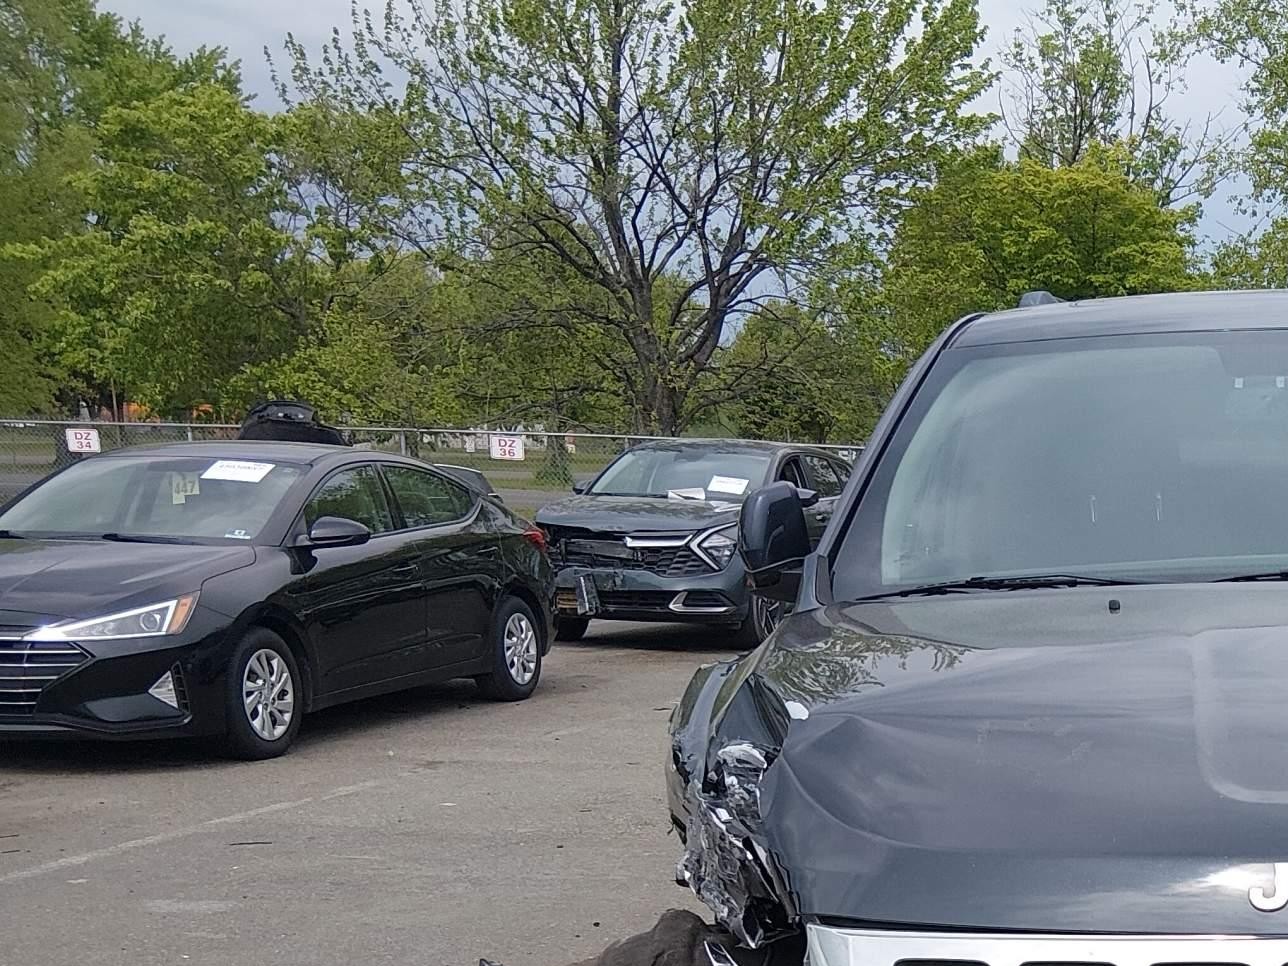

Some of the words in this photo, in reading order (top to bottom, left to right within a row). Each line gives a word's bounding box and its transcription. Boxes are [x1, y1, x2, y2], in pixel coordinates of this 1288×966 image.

[74, 432, 92, 440] DZ
[76, 441, 92, 449] 34
[498, 439, 516, 448] DZ
[500, 448, 516, 457] 36
